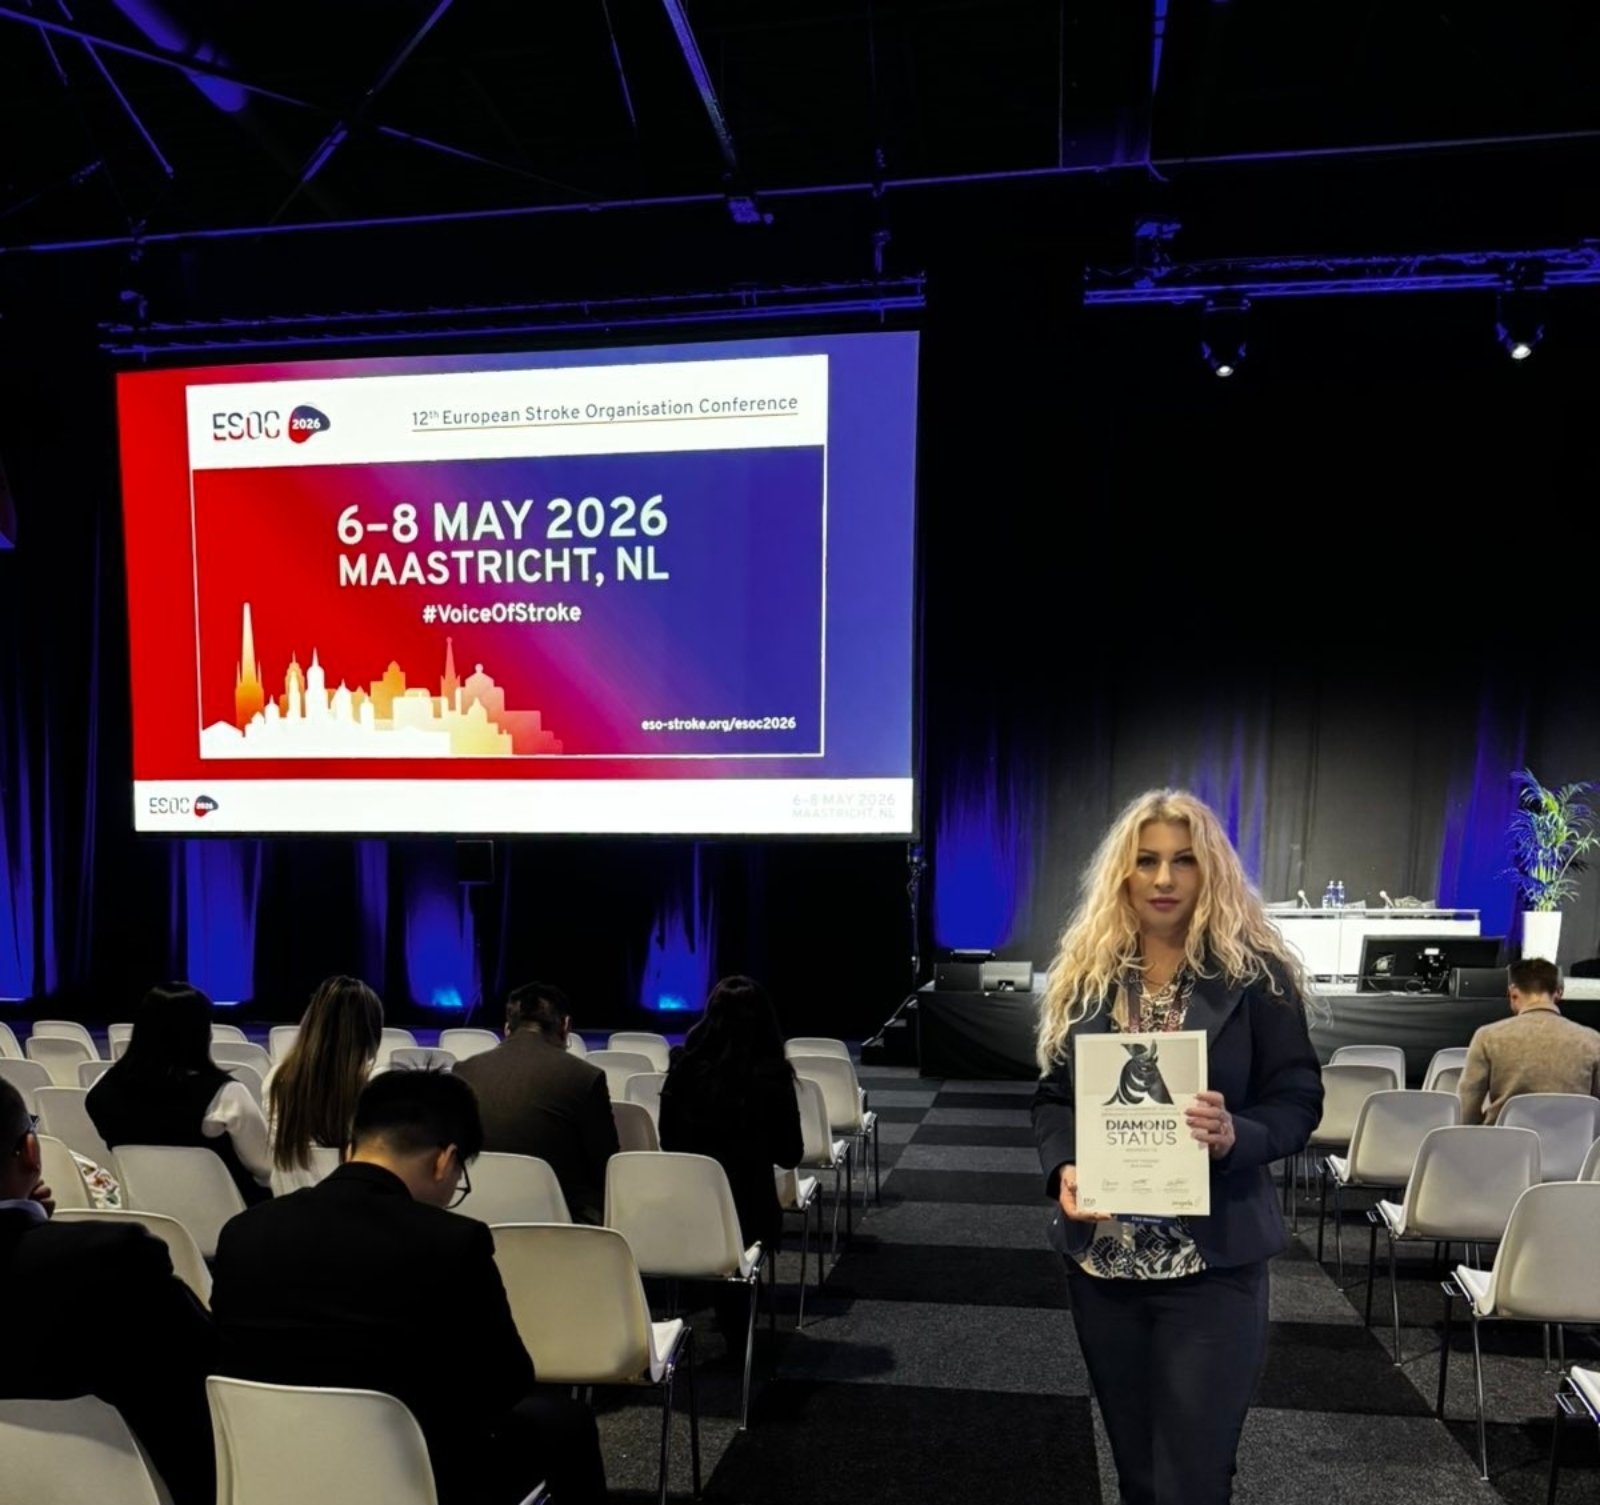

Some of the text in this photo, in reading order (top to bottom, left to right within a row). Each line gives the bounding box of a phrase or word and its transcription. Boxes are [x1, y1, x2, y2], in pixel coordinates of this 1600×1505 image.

[412, 396, 799, 426] 12th European Stroke Organisation Conference
[212, 410, 321, 441] ESOC 2026
[433, 499, 534, 542] MAY
[546, 494, 668, 539] 2026
[338, 545, 670, 587] MAASTRICHT, NL
[422, 602, 582, 624] #VoiceOfStroke
[641, 716, 797, 732] eso-stroke.org/esoc2026
[149, 796, 190, 815] ESOC
[822, 793, 855, 806] MAY
[858, 792, 896, 806] 2026
[1105, 1119, 1177, 1131] DIAMOND
[1106, 1131, 1177, 1146] STATUS
